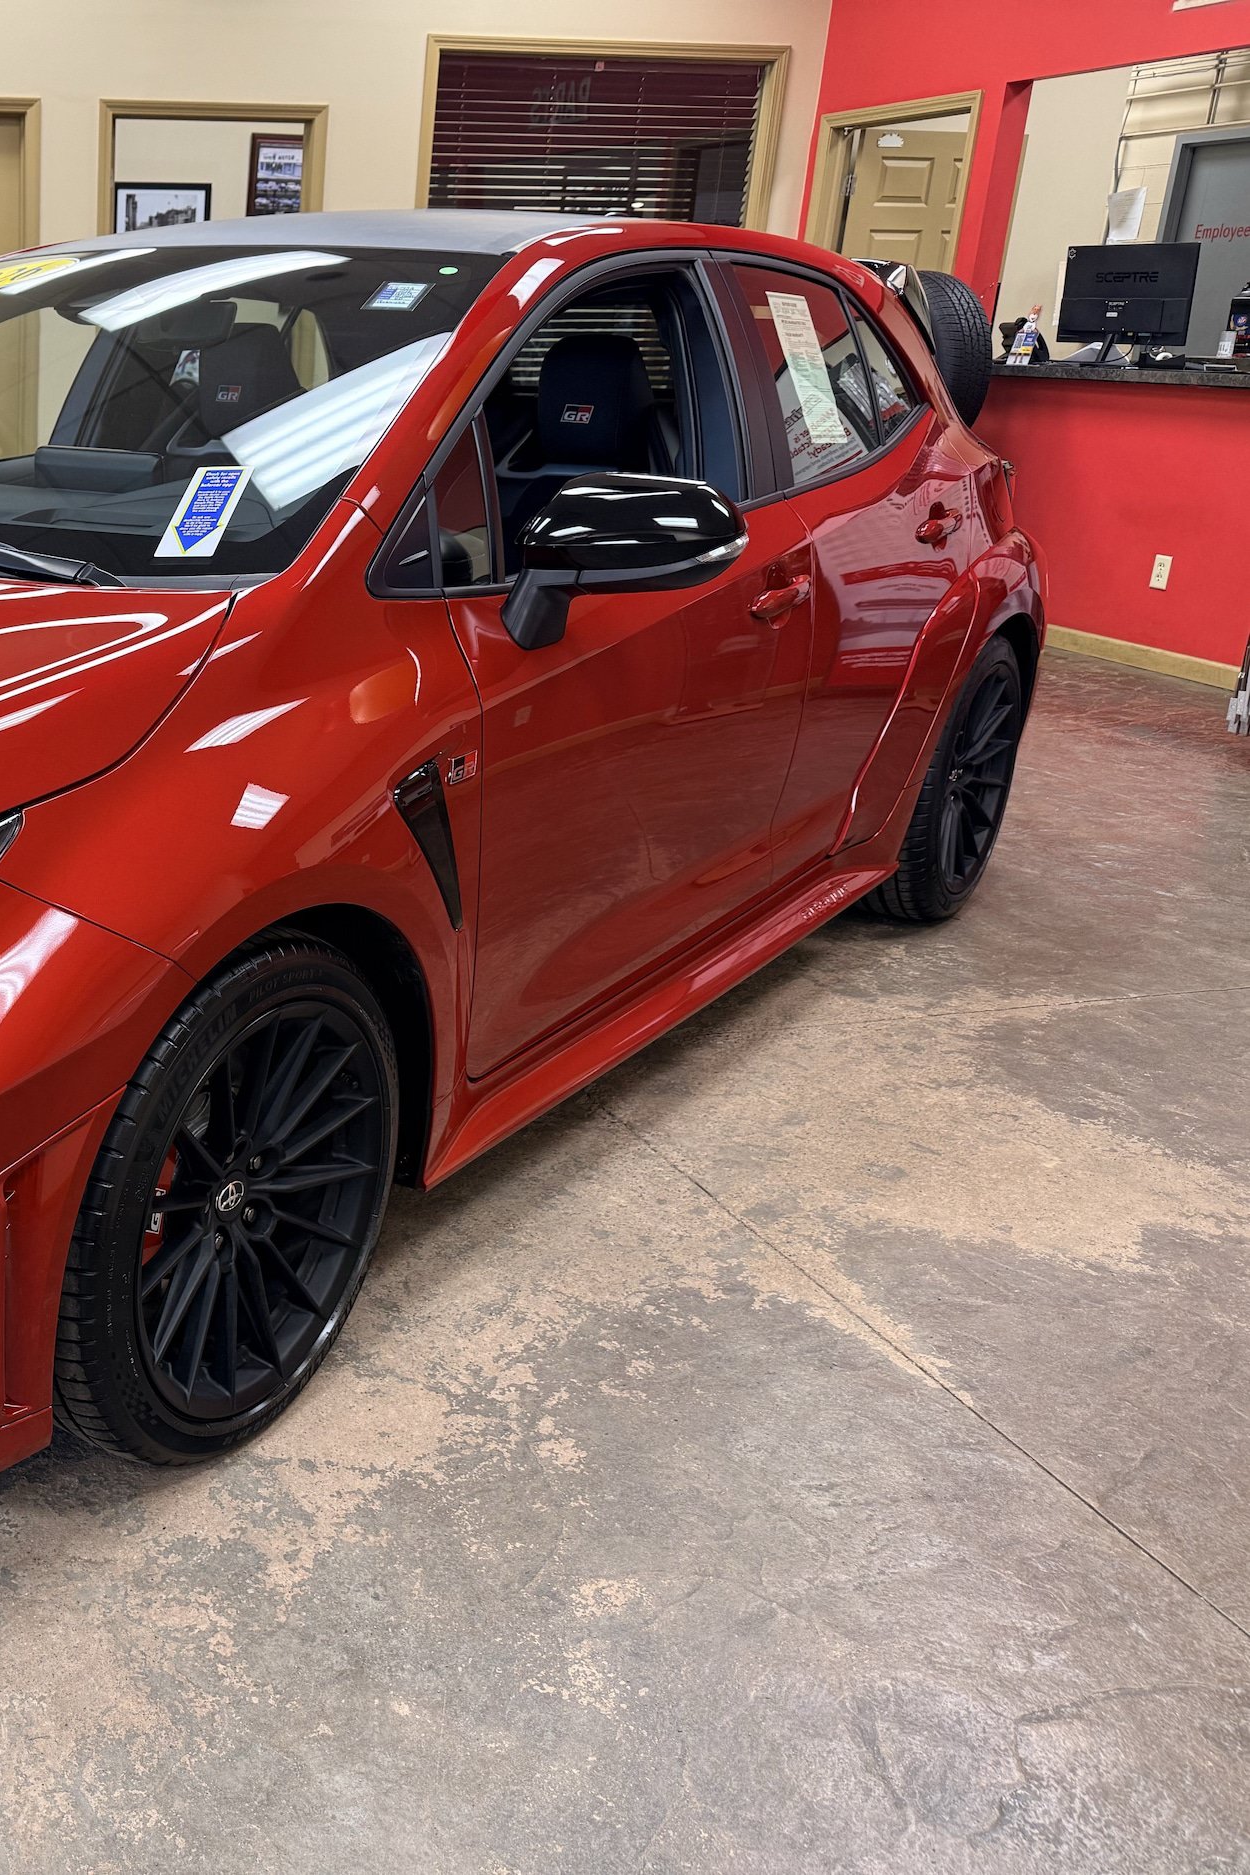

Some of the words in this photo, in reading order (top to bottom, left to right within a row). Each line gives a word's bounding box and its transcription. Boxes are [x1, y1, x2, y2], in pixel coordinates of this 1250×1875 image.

[1095, 271, 1160, 283] SCEPTRE
[217, 391, 238, 401] GR
[563, 411, 590, 422] GR
[452, 761, 475, 781] GR
